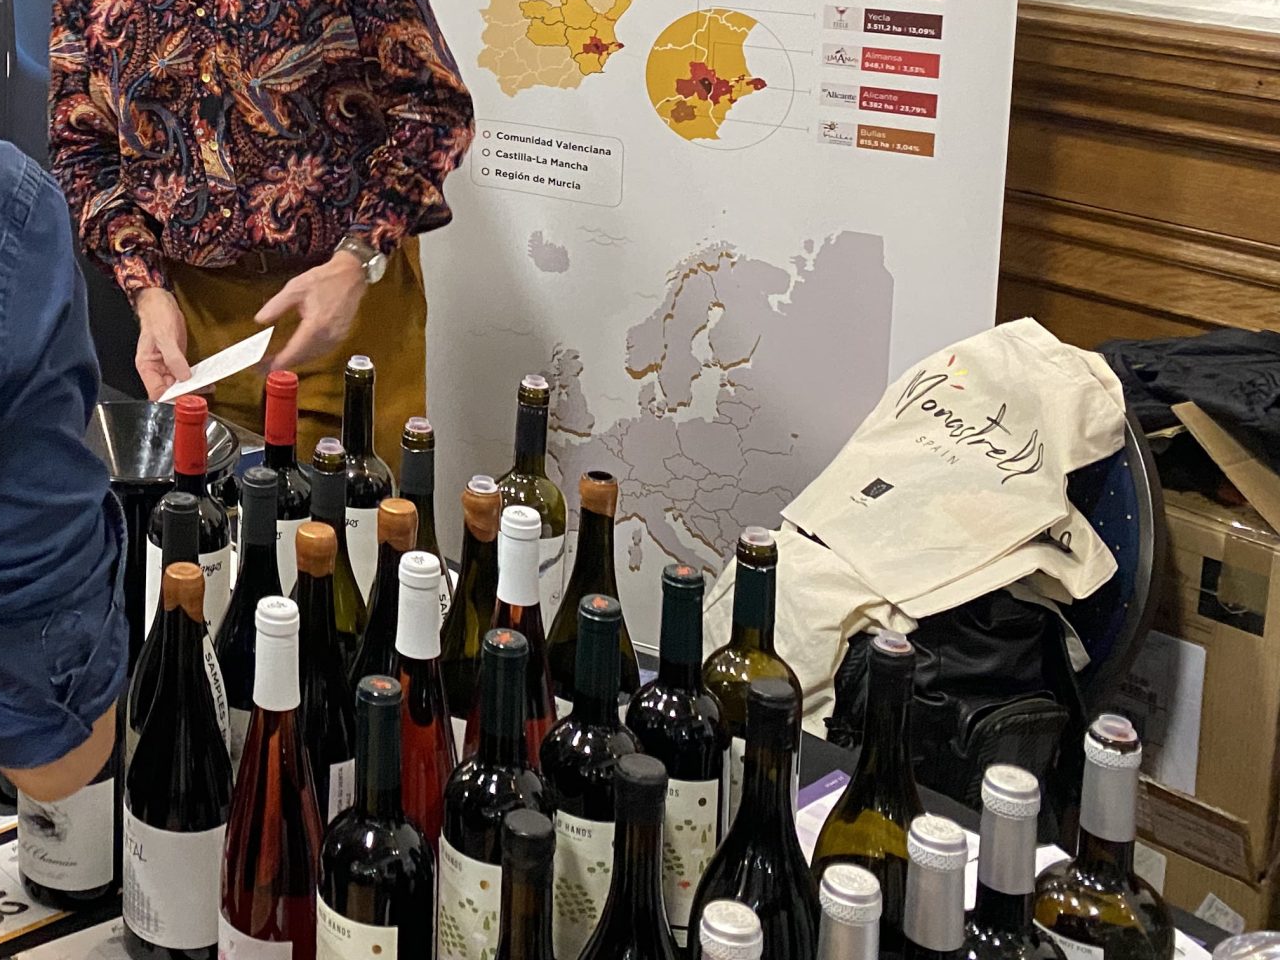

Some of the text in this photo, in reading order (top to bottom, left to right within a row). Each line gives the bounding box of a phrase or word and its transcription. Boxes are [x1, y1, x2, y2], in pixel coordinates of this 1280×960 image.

[867, 12, 891, 22] Yecla
[892, 24, 902, 32] ha
[908, 26, 936, 36] 13,09%
[865, 51, 903, 62] Almansa
[885, 63, 895, 71] ha
[862, 90, 899, 102] Alicante
[884, 102, 894, 110] ha
[860, 128, 887, 139] Bullas
[496, 131, 612, 156] Comunidad Valenciana
[880, 141, 890, 149] ha
[495, 149, 589, 172] Castilla-La Mancha
[494, 168, 581, 190] Región de Murcia
[895, 369, 1044, 485] Monastrell
[915, 435, 960, 466] SPAIN
[204, 651, 226, 721] SAMPLES
[565, 823, 592, 839] HANDS
